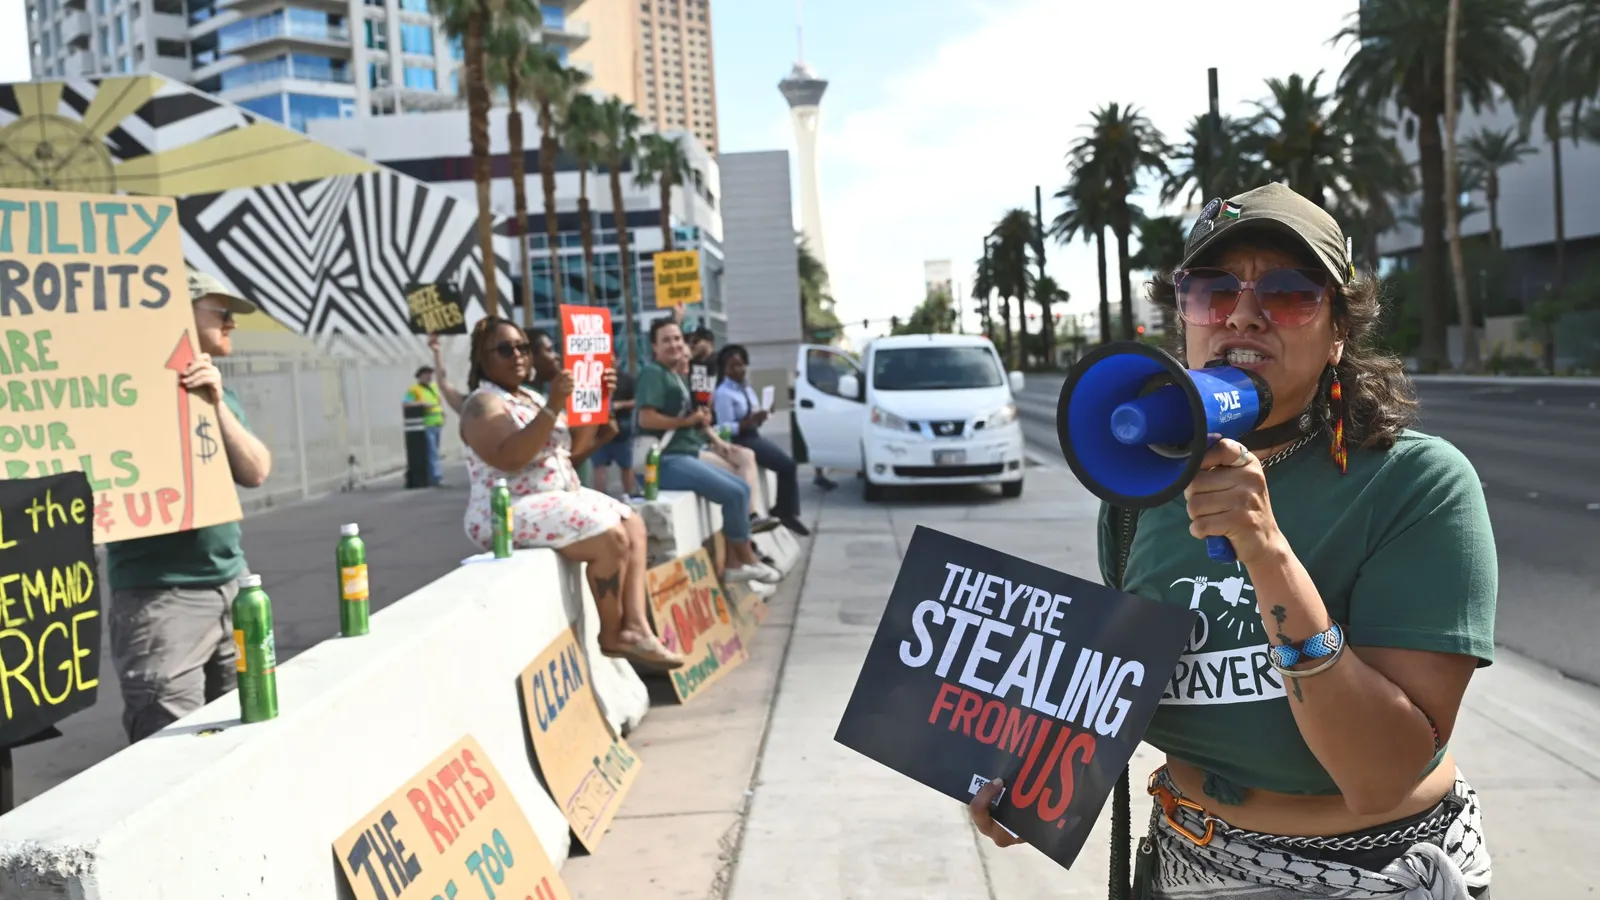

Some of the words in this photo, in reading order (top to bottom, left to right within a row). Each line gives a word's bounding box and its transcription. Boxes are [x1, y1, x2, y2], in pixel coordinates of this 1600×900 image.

[570, 314, 604, 335] YOUR
[571, 337, 609, 352] PROFITS
[573, 361, 604, 388] OUR
[575, 391, 600, 409] PAIN
[25, 490, 86, 533] the
[124, 487, 182, 528] UP
[938, 562, 1073, 637] THEY'RE
[0, 610, 99, 719] RGE
[533, 643, 584, 732] CLEAN
[898, 599, 1146, 739] STEALING
[1161, 651, 1283, 700] PAYER
[927, 682, 1038, 758] FROM
[1010, 717, 1097, 830] US.
[347, 810, 423, 900] THE
[406, 748, 496, 855] RATES
[465, 828, 514, 900] TOO
